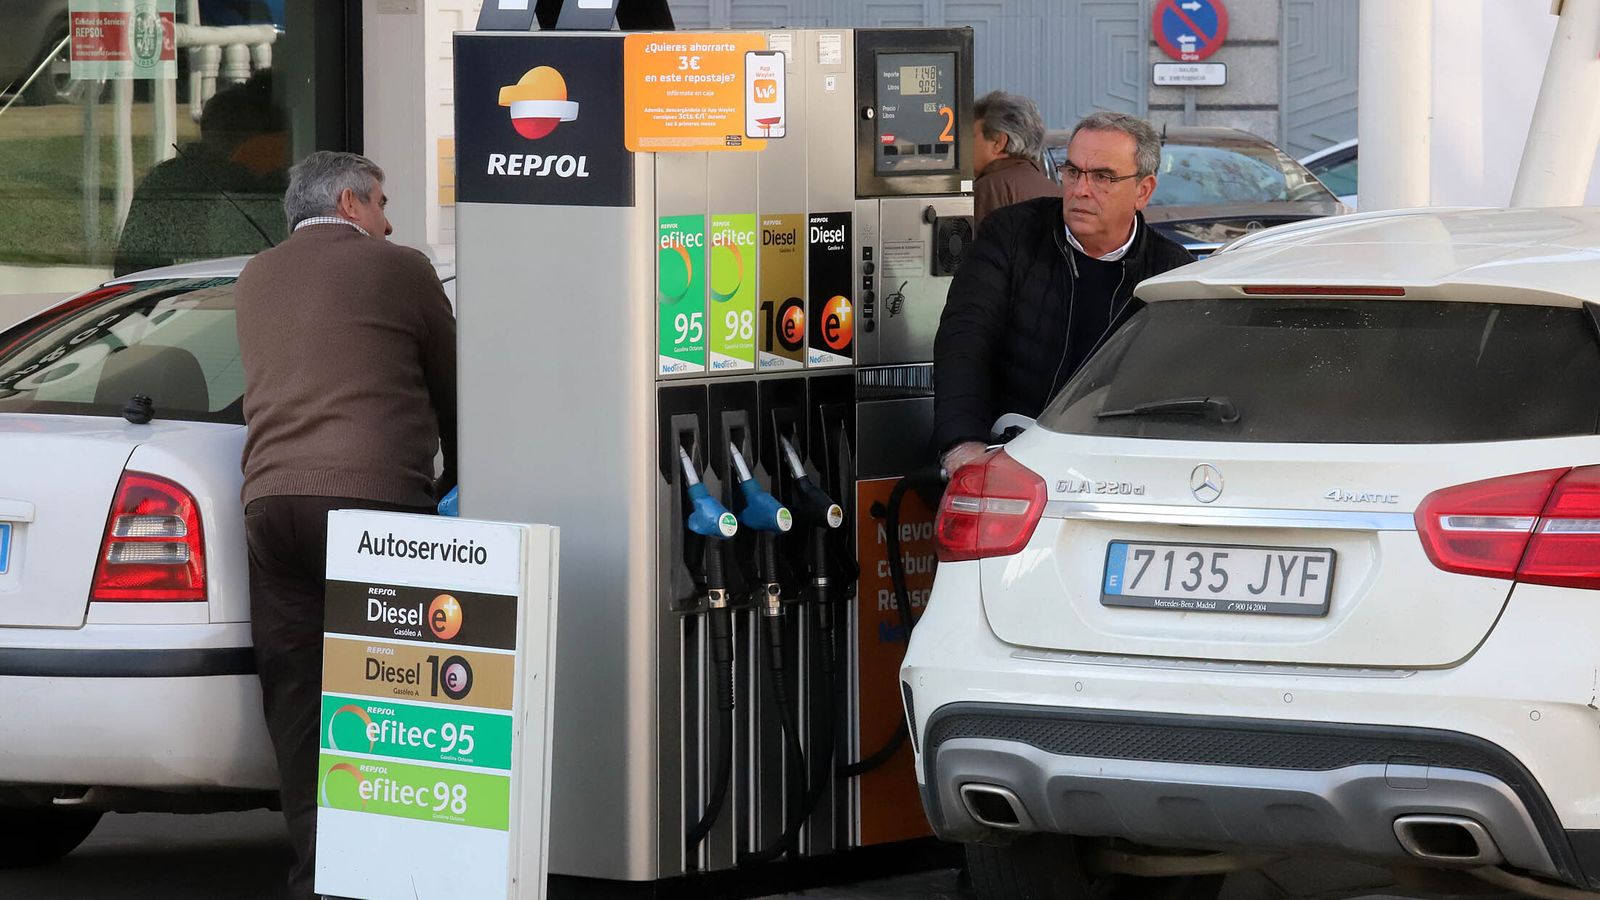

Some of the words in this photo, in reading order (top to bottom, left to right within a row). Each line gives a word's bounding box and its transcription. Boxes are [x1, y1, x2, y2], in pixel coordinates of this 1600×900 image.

[76, 27, 104, 38] REPSOL
[645, 43, 687, 52] ¿Quieres
[690, 43, 736, 52] ahorrarte
[660, 74, 682, 82] este
[684, 74, 736, 84] repostaje?
[939, 106, 954, 142] 2
[487, 153, 590, 178] REPSOL
[661, 231, 703, 249] efitec
[713, 230, 754, 246] efitec
[763, 229, 796, 246] Diesel
[810, 225, 845, 243] Diesel
[674, 312, 703, 344] 95
[725, 310, 753, 341] 98
[760, 297, 804, 352] 10
[713, 360, 737, 369] NeoTech
[760, 358, 784, 367] NeoTech
[810, 354, 833, 364] NeoTech
[662, 364, 687, 372] NeoTech
[1056, 480, 1090, 494] GLA
[1094, 481, 1145, 495] 220d
[1324, 488, 1399, 504] 4MATIC
[357, 531, 487, 565] Autoservicio
[1110, 575, 1118, 586] E
[1129, 550, 1229, 593] 7135
[1247, 554, 1325, 597] JYF
[368, 588, 396, 596] REPSOL
[367, 598, 423, 626] Diesel
[1154, 600, 1194, 608] Mercedes-Benz
[1196, 601, 1216, 609] Madrid
[394, 628, 416, 637] Gasóleo
[366, 646, 394, 655] REPSOL
[366, 658, 420, 685] Diesel
[427, 655, 473, 700] 10
[393, 688, 414, 696] Gasóleo
[367, 706, 395, 715] REPSOL
[366, 720, 437, 748] efitec
[441, 722, 474, 755] 95
[360, 765, 388, 774] REPSOL
[358, 778, 429, 806] efitec
[433, 782, 467, 814] 98
